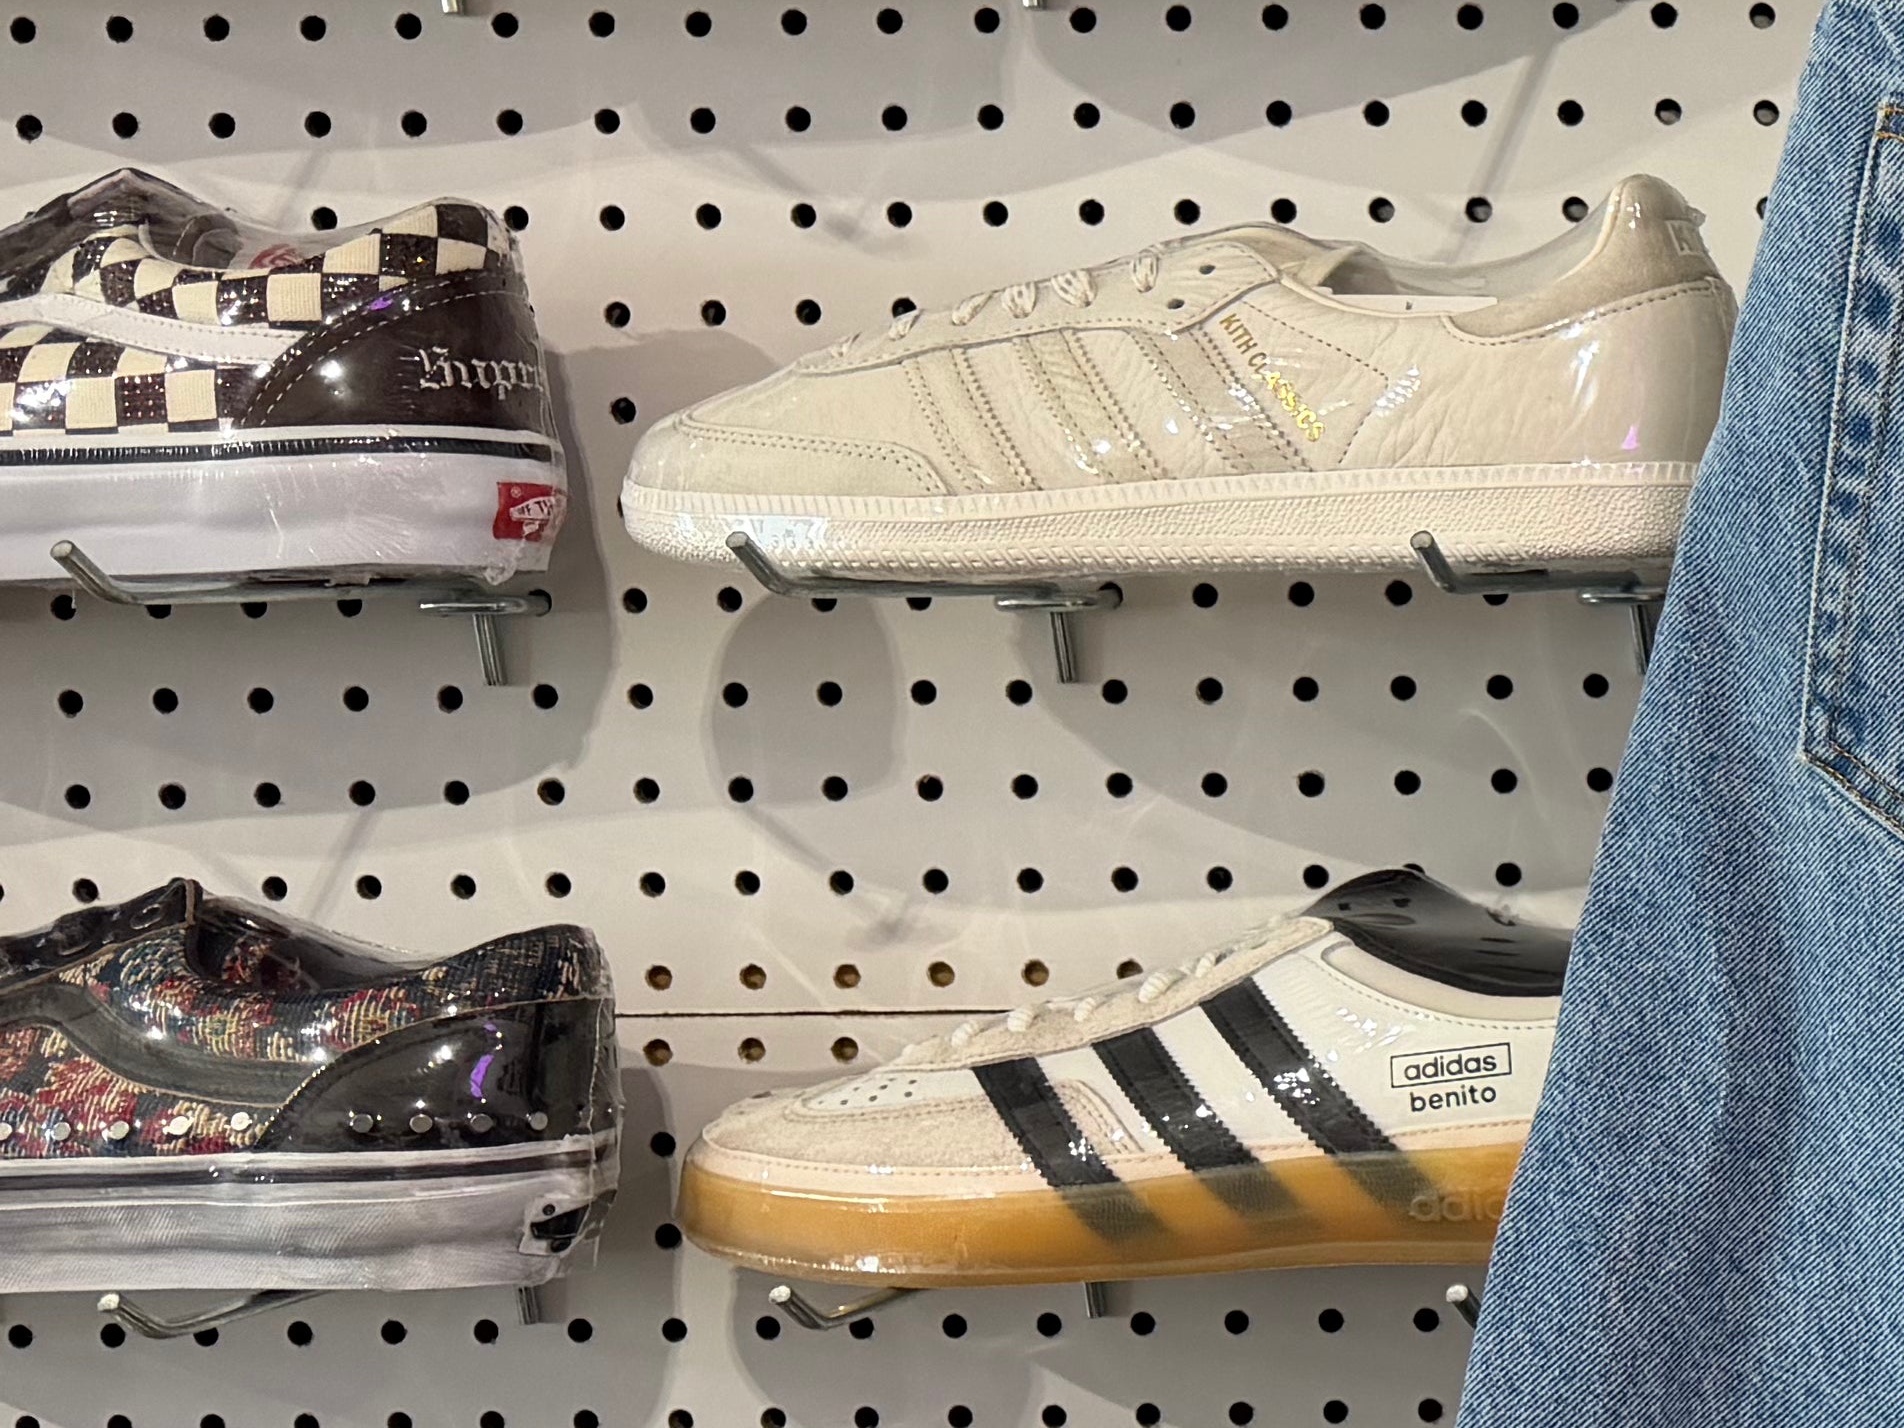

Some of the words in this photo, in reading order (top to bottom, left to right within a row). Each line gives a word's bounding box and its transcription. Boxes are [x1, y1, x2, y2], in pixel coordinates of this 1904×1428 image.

[1219, 312, 1258, 355] KITH
[1404, 1054, 1497, 1081] adidas
[1410, 1084, 1497, 1112] benito
